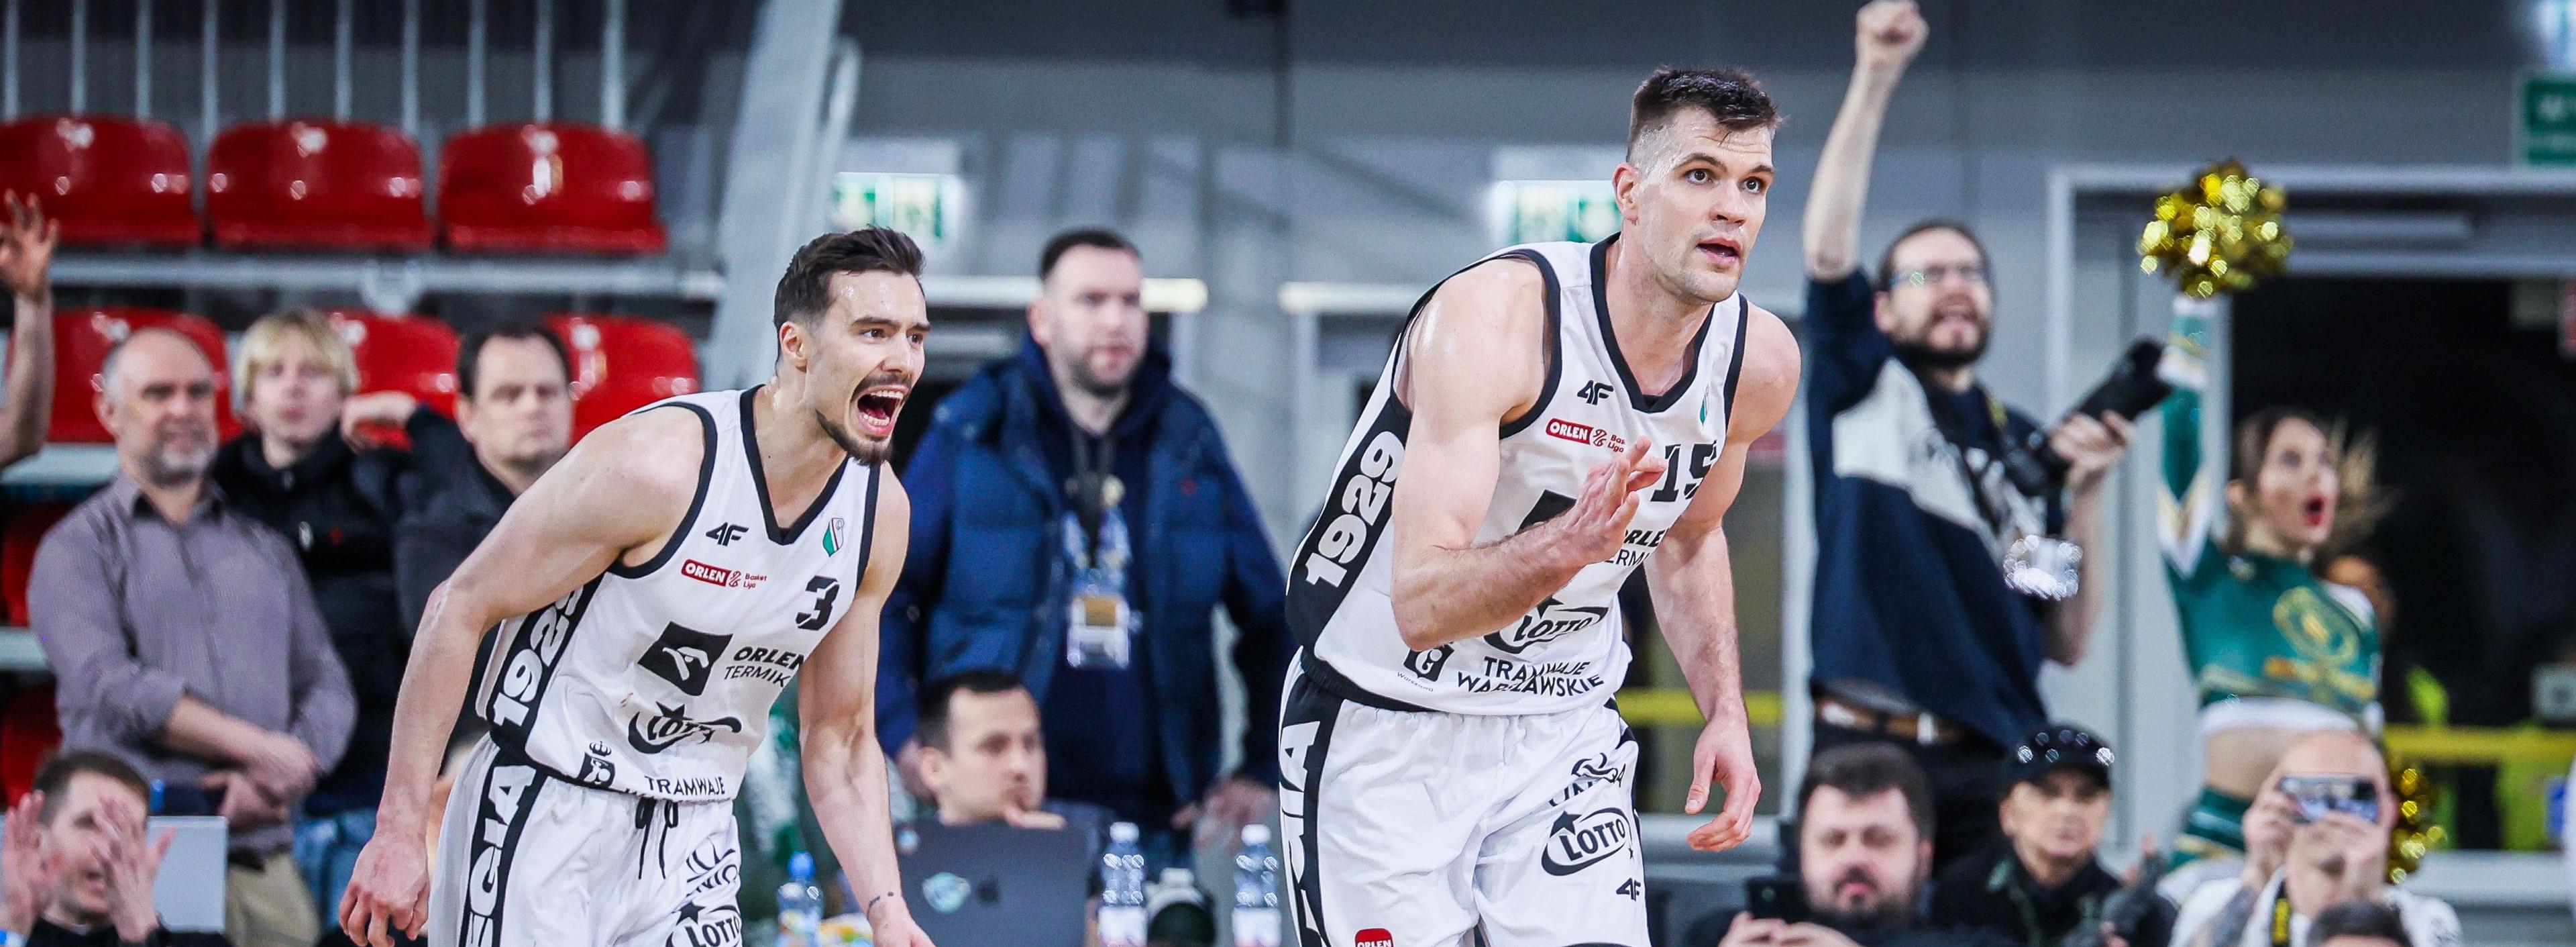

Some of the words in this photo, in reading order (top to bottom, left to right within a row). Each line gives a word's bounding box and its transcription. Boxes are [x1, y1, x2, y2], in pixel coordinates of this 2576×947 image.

[1576, 380, 1614, 405] 4F
[1550, 421, 1589, 441] ORLEN
[1650, 440, 1717, 502] 15
[1305, 431, 1405, 588] 1929
[706, 521, 749, 547] 4F
[1623, 529, 1666, 548] RLE
[685, 562, 727, 583] ORLEN
[745, 573, 767, 581] Basket
[796, 575, 840, 631] 3
[1513, 614, 1593, 642] LOTTO
[733, 646, 805, 670] ORLEN
[644, 775, 725, 796] TRAMWAJE
[1559, 818, 1626, 862] LOTTO
[1616, 878, 1642, 901] 4F
